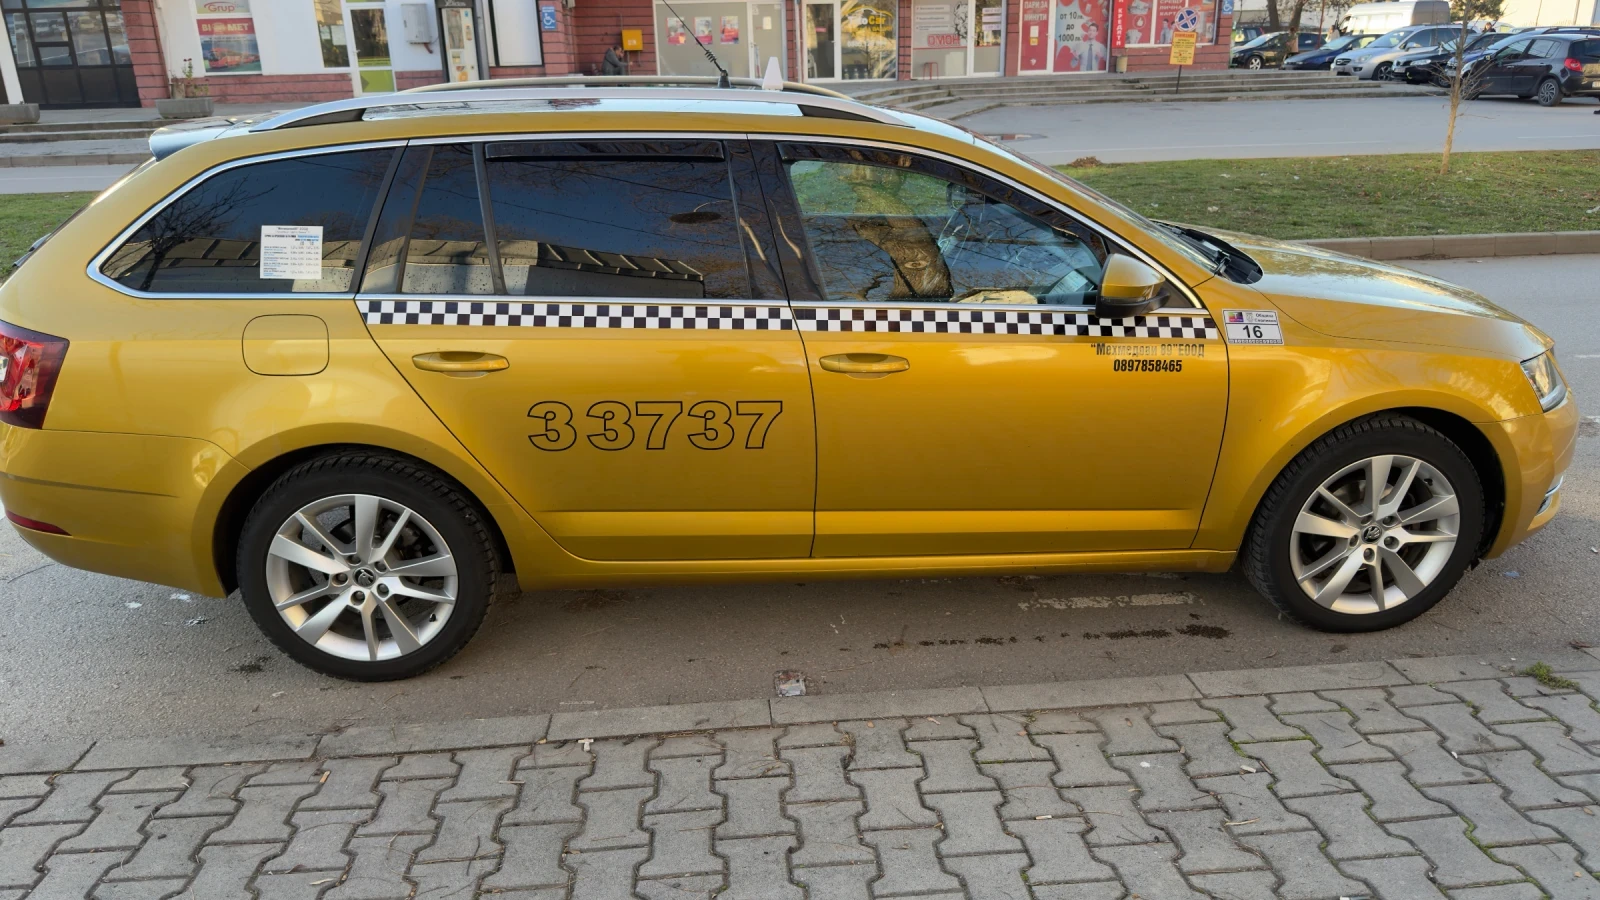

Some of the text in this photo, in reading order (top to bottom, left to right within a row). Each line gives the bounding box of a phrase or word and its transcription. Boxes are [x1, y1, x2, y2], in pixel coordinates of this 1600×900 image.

[207, 3, 235, 13] Grup
[1023, 13, 1047, 21] МИНУТИ
[1066, 23, 1075, 31] до
[1058, 33, 1074, 42] 1000
[1242, 324, 1263, 339] 16
[1113, 359, 1183, 372] 0897858465
[527, 400, 783, 451] 33737
